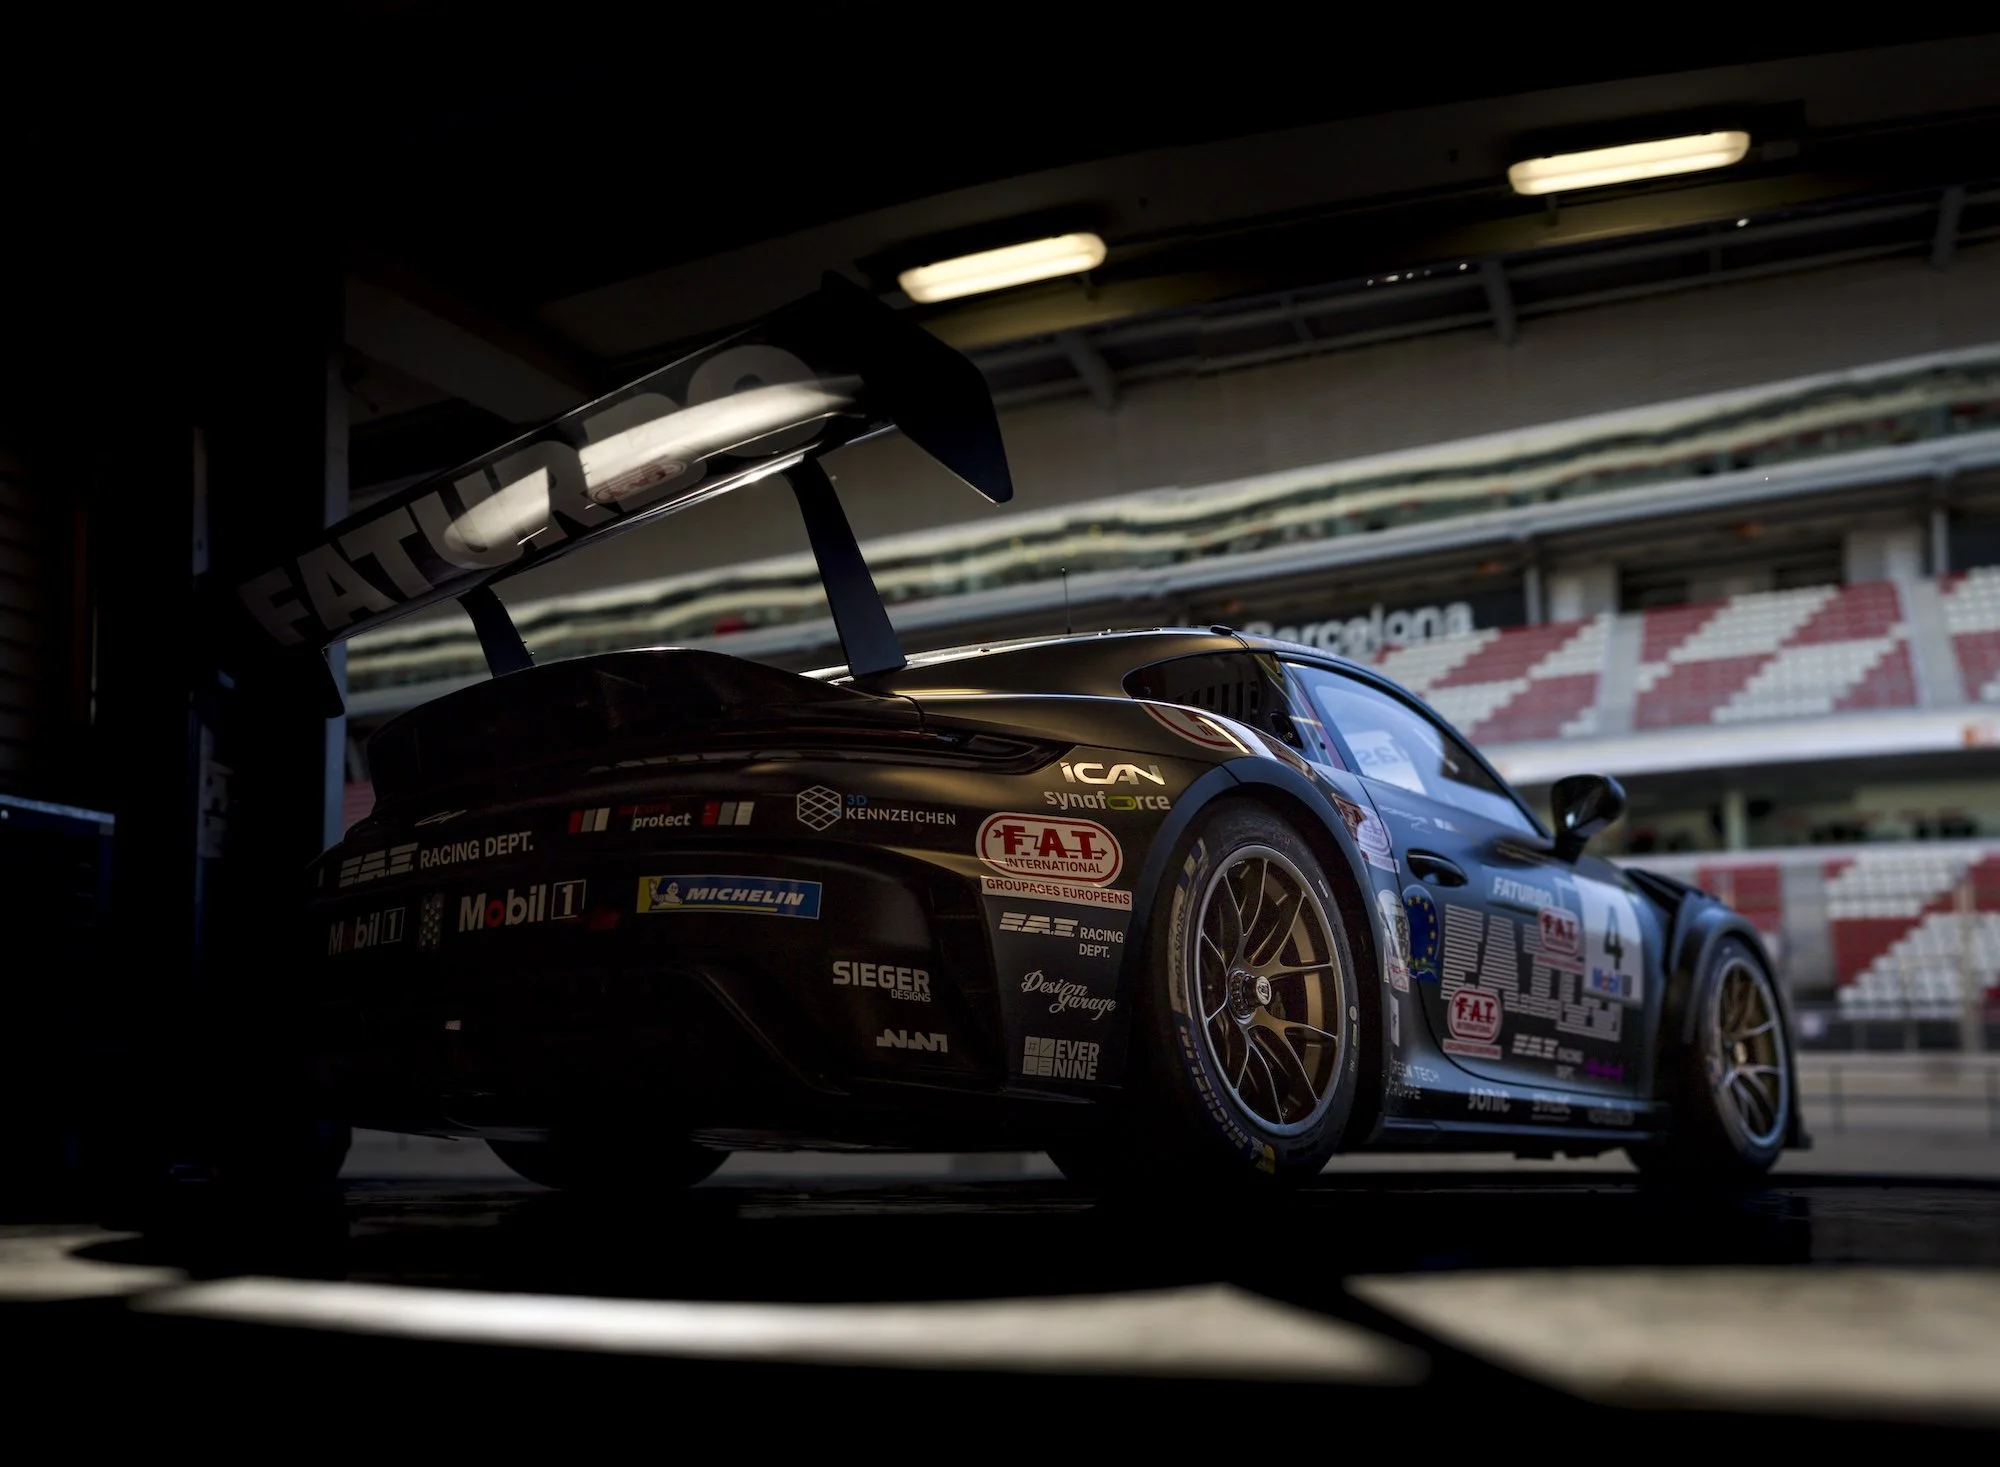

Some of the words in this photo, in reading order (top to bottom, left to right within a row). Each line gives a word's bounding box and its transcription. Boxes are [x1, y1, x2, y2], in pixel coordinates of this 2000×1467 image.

[237, 344, 828, 647] FATURBO
[630, 811, 692, 832] protect
[846, 807, 957, 826] KENNZEICHEN
[420, 840, 480, 870] RACING
[484, 830, 535, 859] DEPT.
[1004, 857, 1103, 874] INTERNATIONAL
[685, 887, 805, 906] MICHELIN
[986, 879, 1060, 897] GROUPAGES
[1062, 888, 1130, 905] EUROPEENS
[459, 884, 547, 933] Mobil
[327, 911, 381, 957] Mobil
[1080, 926, 1124, 944] RACING
[1605, 904, 1623, 971] 4
[1079, 943, 1111, 959] DEPT.
[832, 961, 931, 994] SIEGER
[1020, 969, 1088, 999] Design
[890, 989, 931, 1003] DESIGNS
[1049, 988, 1117, 1020] Garage
[1055, 1039, 1100, 1062] EVER
[1053, 1059, 1098, 1080] NINE
[1180, 1025, 1249, 1150] MICHELIN
